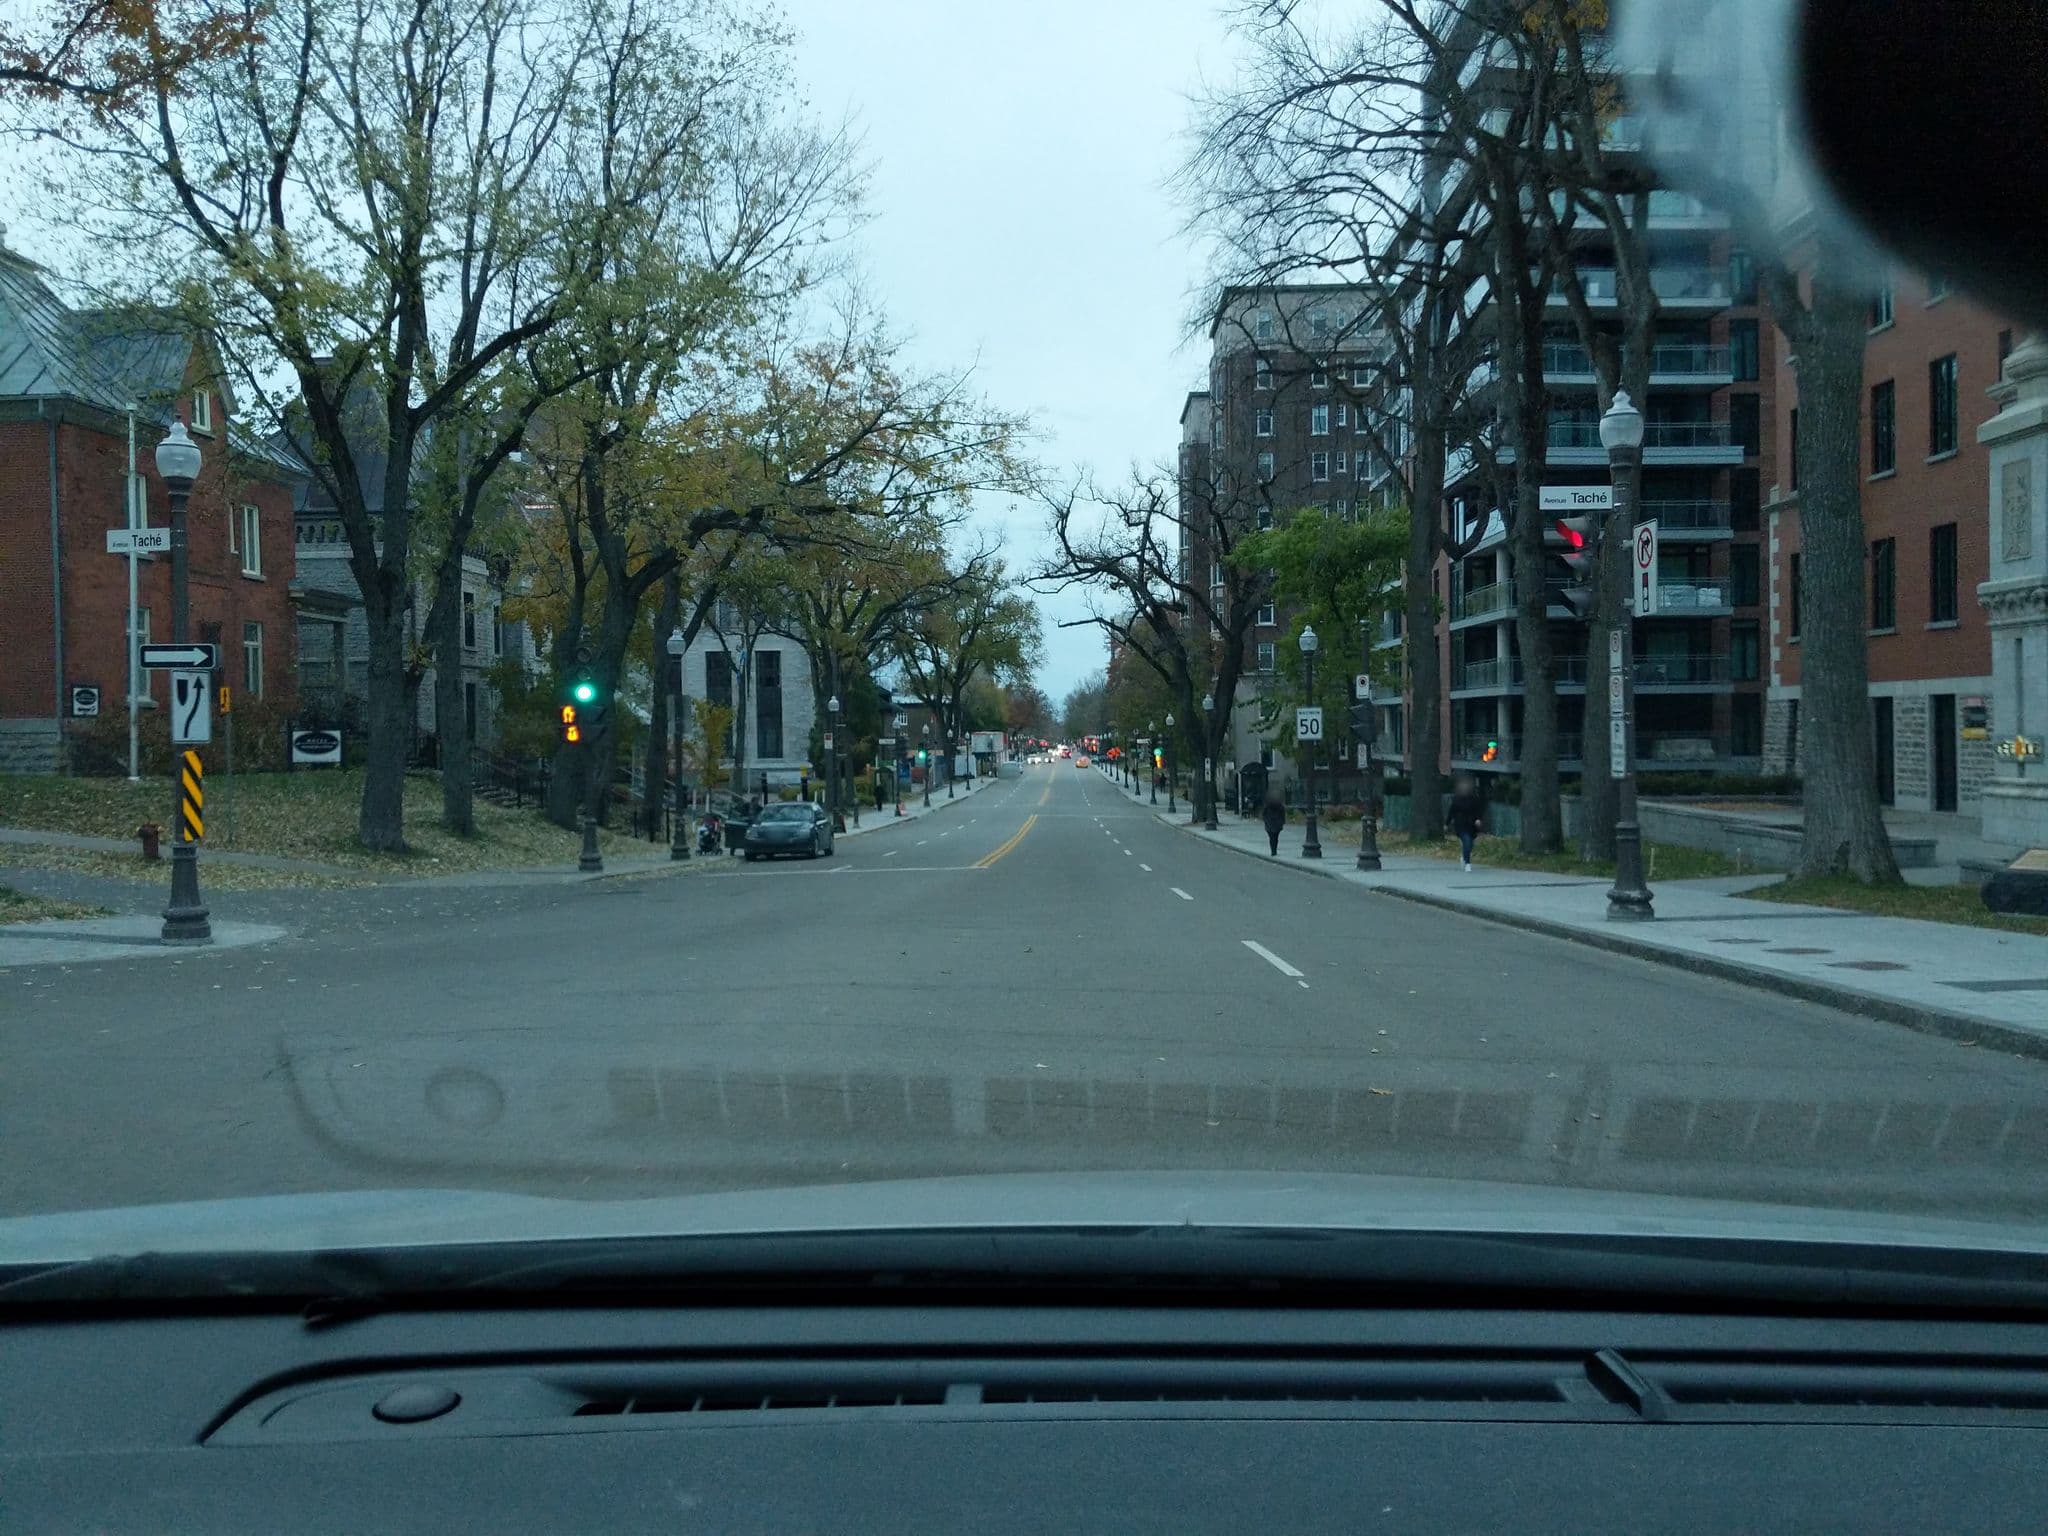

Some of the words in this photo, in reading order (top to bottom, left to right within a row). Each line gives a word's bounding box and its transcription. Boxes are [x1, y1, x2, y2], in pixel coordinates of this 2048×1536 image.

[1571, 492, 1607, 504] Taché
[132, 533, 162, 547] Taché
[1300, 718, 1320, 735] 50
